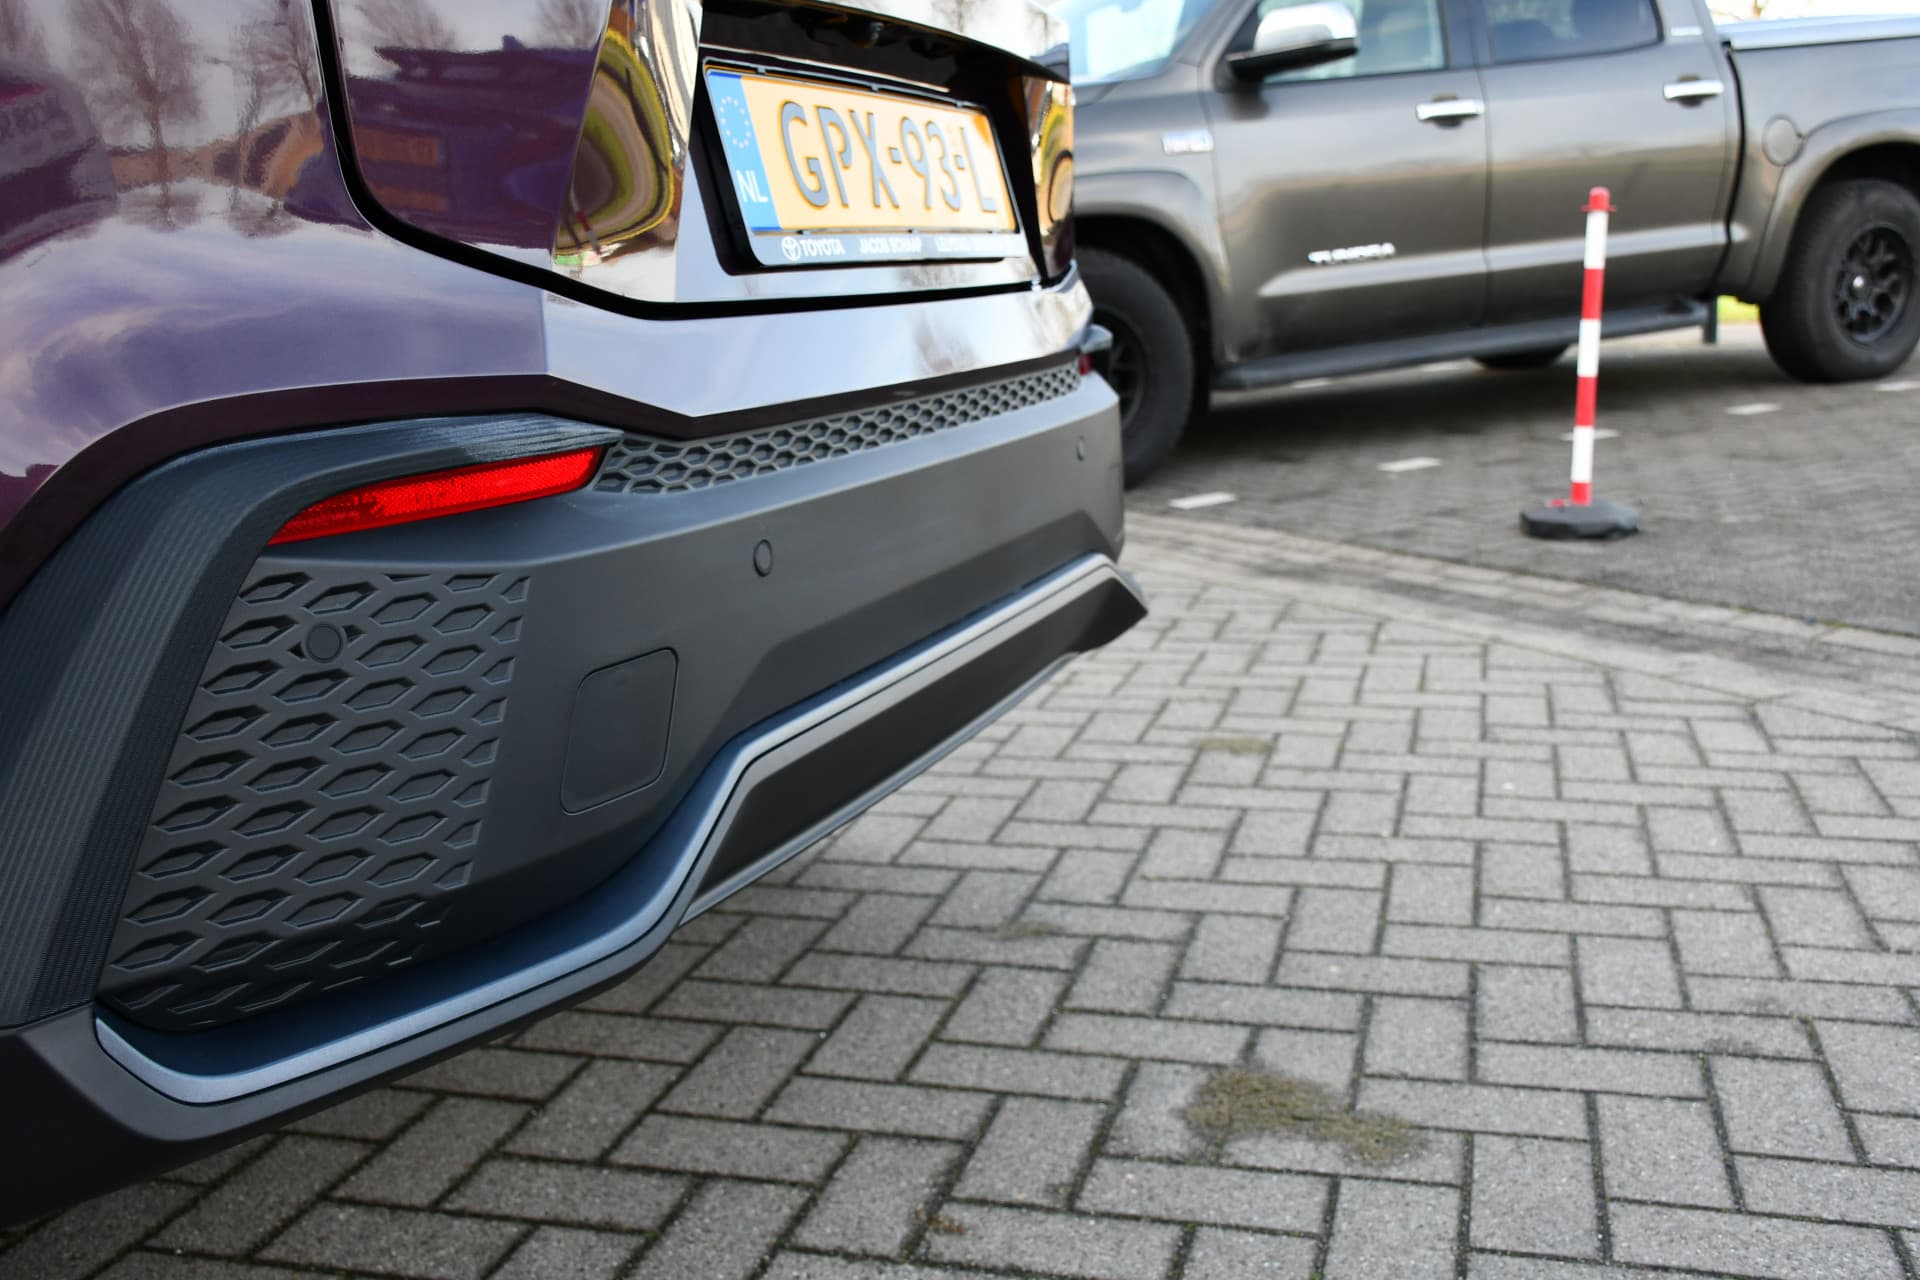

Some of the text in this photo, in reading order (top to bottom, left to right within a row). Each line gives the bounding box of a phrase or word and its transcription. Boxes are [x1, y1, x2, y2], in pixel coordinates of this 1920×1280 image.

[780, 100, 998, 212] GPX-93-L
[737, 169, 768, 203] NL
[799, 239, 845, 256] TOYOTA
